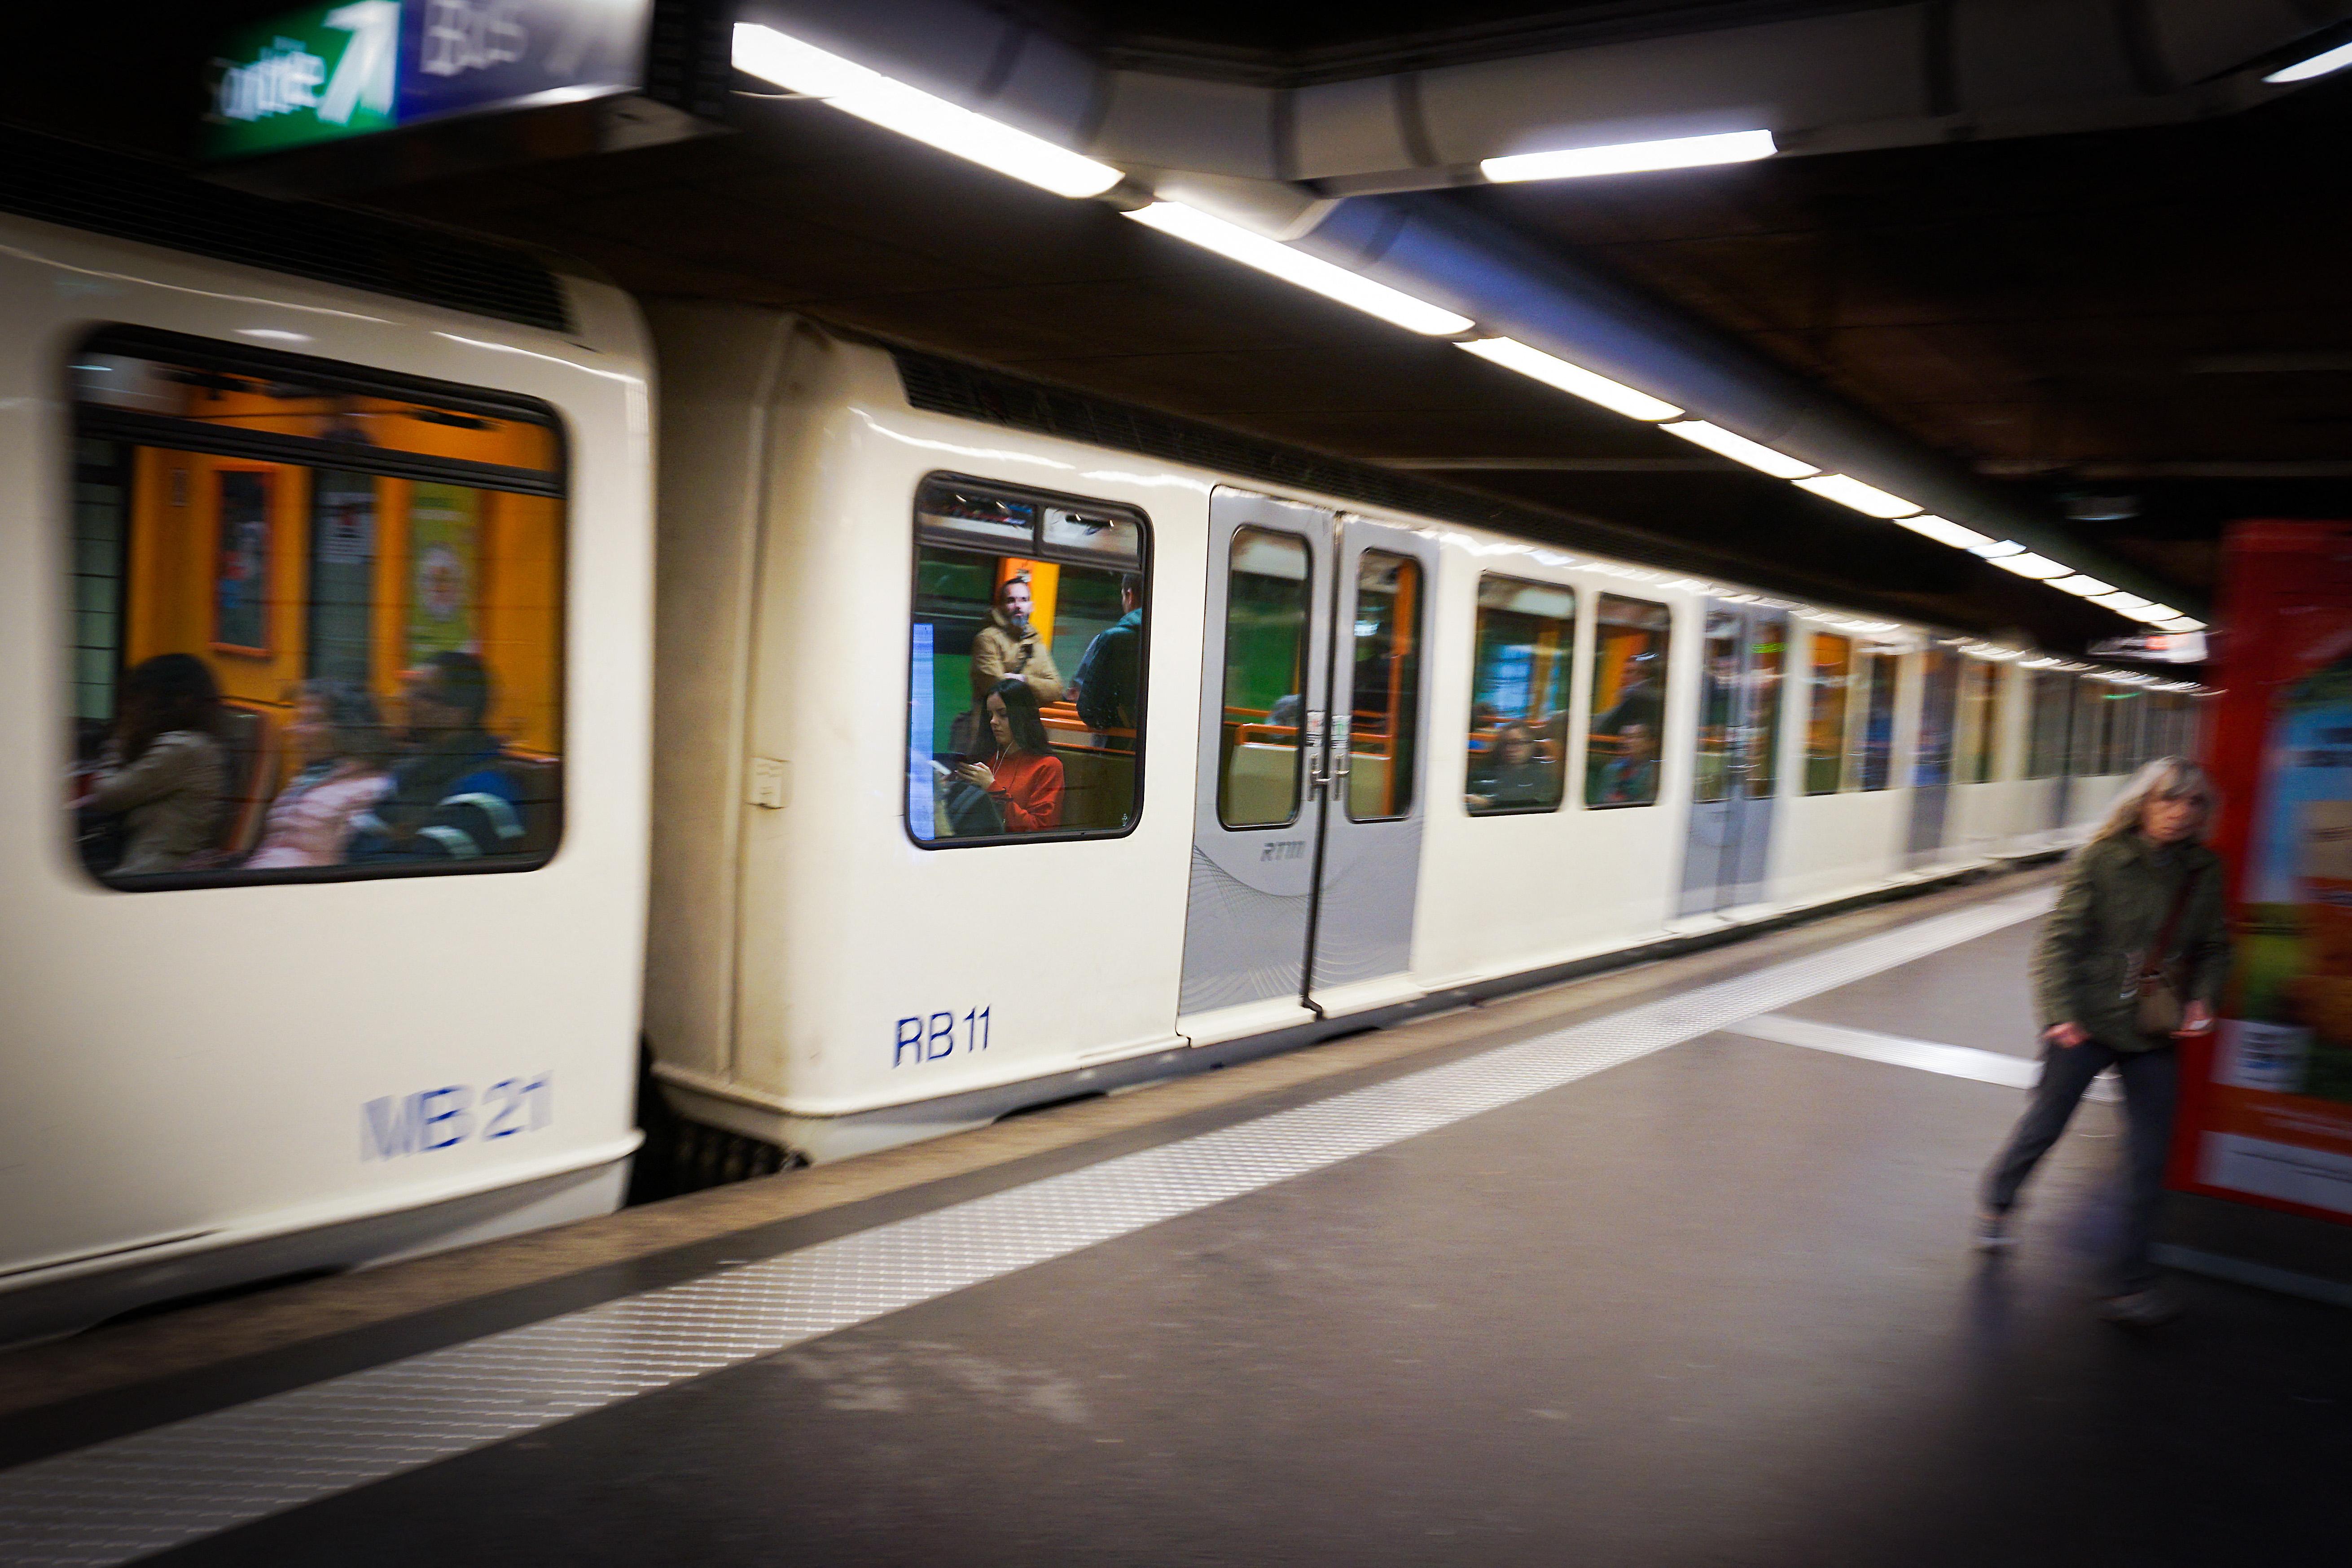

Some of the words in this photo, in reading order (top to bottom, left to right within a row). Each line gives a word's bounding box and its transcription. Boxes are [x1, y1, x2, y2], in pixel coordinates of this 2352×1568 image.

[892, 1011, 953, 1068] RB
[963, 1003, 991, 1054] 11
[361, 1084, 477, 1163] MB
[480, 1070, 554, 1142] 21
